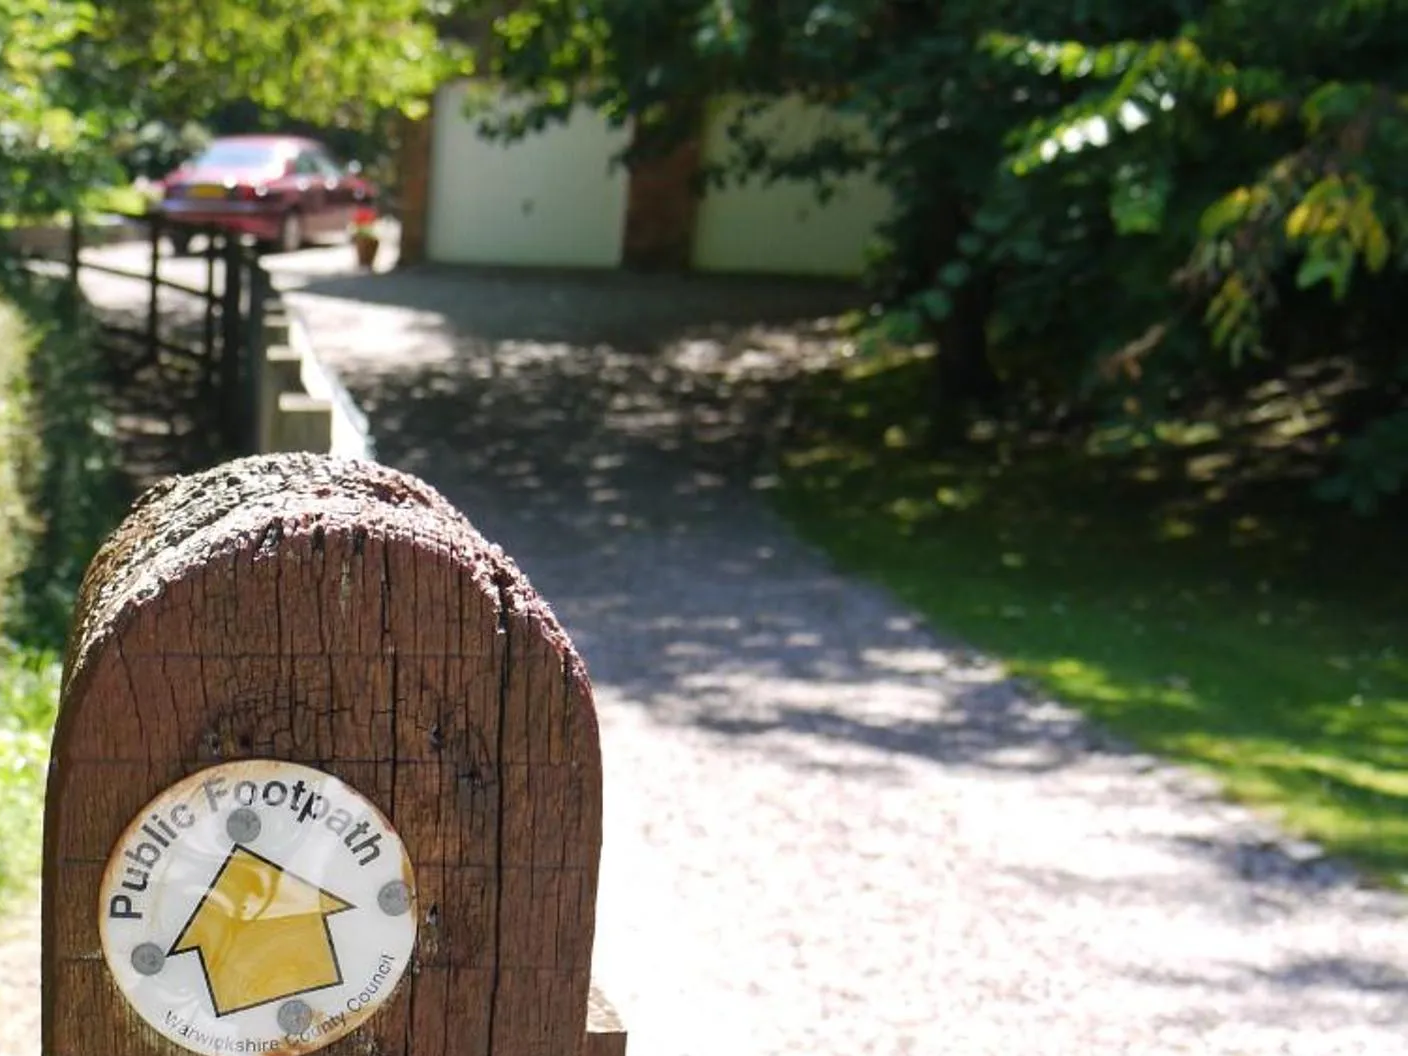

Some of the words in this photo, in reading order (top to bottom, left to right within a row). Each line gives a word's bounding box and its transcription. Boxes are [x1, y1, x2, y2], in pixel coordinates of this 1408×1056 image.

[109, 802, 196, 920] Public
[203, 774, 383, 867] Footpath
[164, 1009, 279, 1052] Warwickshire
[346, 952, 396, 1013] Council
